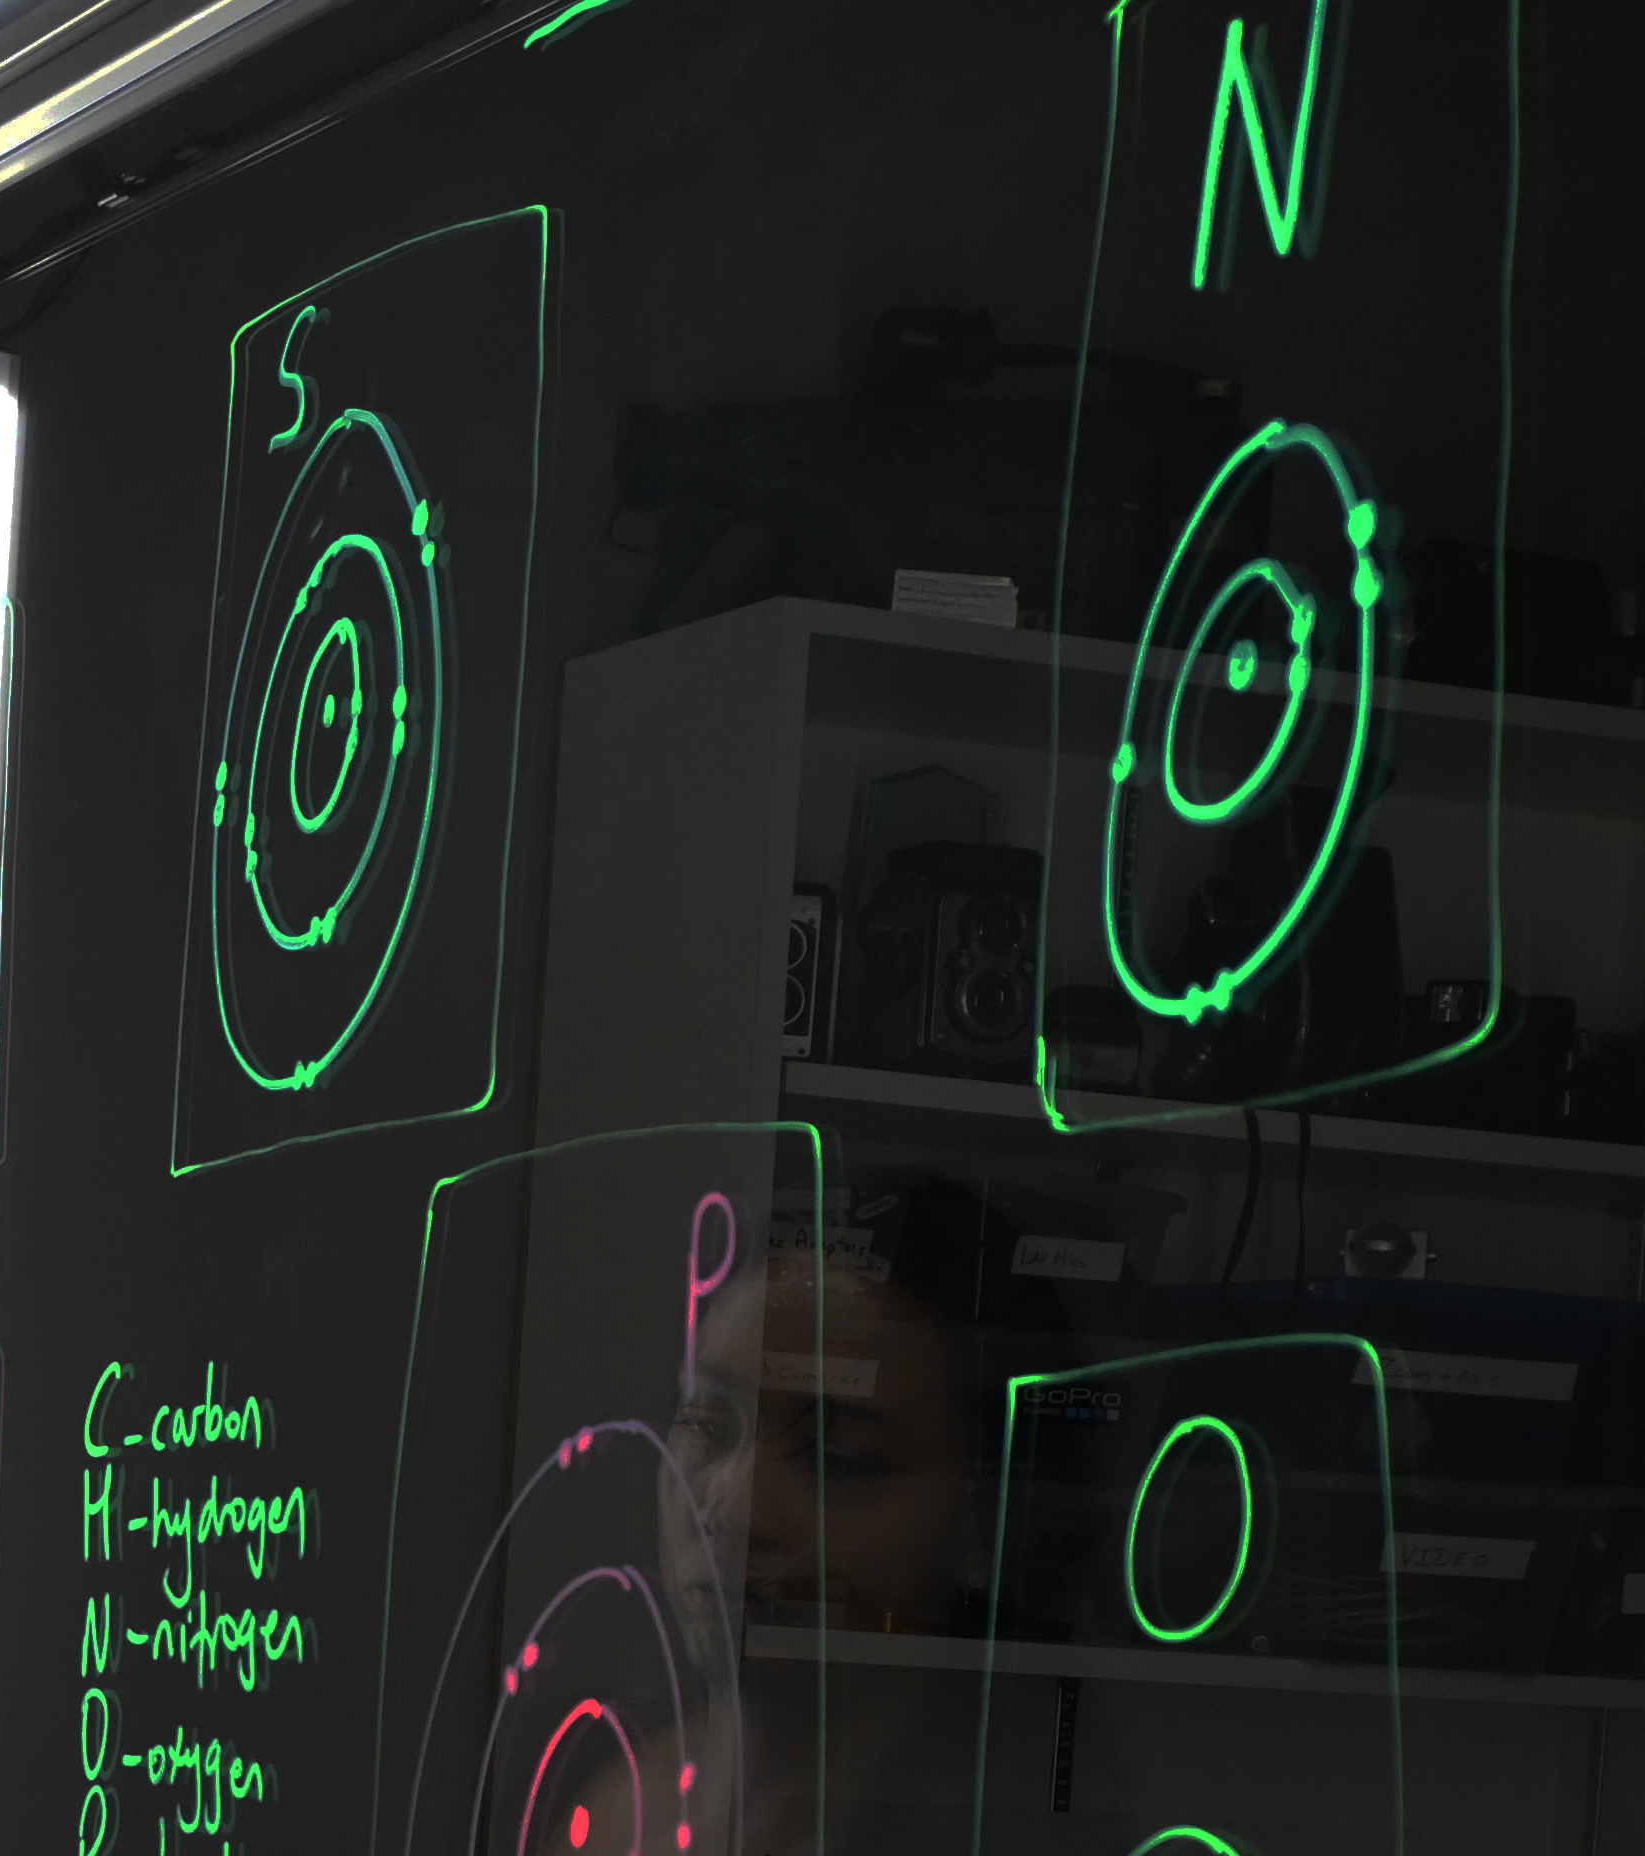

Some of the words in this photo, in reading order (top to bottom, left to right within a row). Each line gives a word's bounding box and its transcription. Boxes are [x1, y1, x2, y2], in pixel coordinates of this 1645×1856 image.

[1191, 0, 1328, 290] N
[266, 304, 317, 455] S
[683, 1190, 737, 1397] P
[1023, 1386, 1122, 1407] GoPro
[1123, 1413, 1253, 1644] O
[1400, 1543, 1489, 1568] VIDEO
